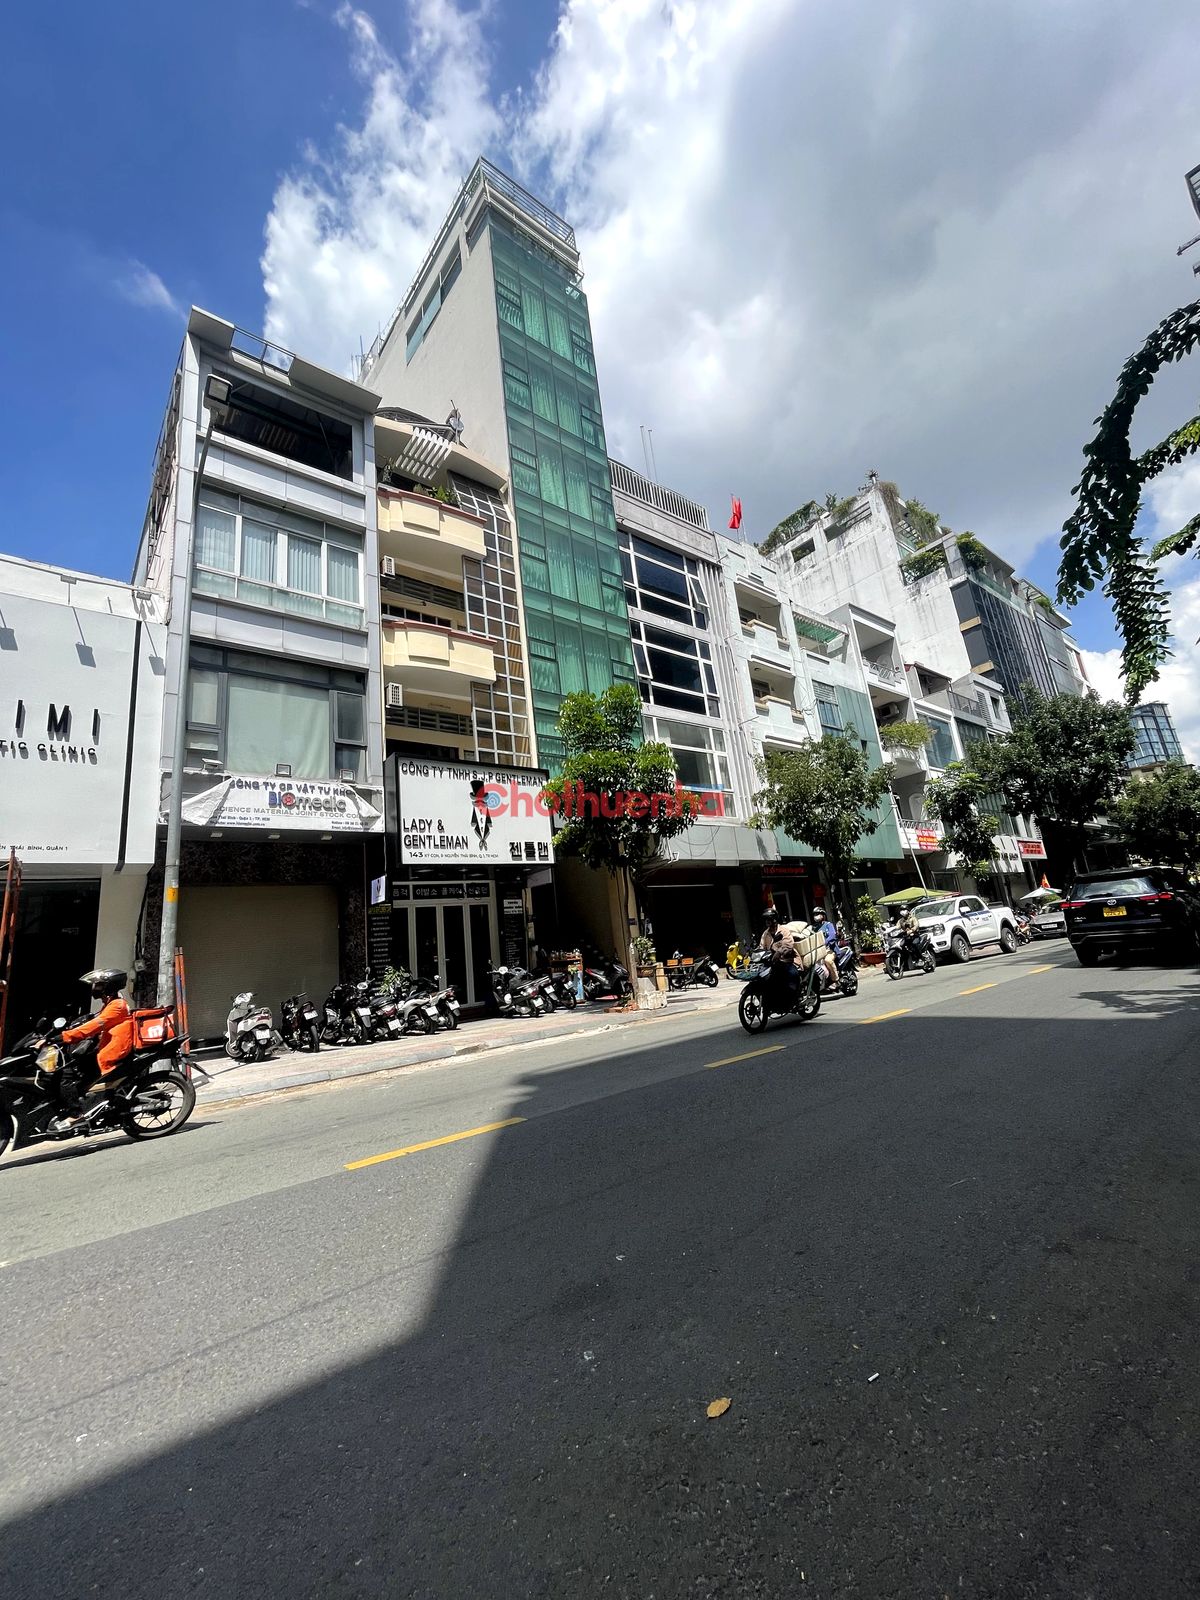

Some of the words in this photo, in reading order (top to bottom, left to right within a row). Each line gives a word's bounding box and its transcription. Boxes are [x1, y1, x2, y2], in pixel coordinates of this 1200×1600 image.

[37, 743, 97, 758] CLINIC
[401, 761, 429, 776] CÔNG
[431, 765, 444, 777] TY
[447, 767, 471, 781] TNHH
[495, 772, 544, 787] GENTLEMAN
[263, 781, 276, 791] TY
[403, 818, 432, 833] LADY
[437, 819, 445, 833] &
[403, 834, 468, 850] GENTLEMAN
[509, 841, 549, 861] 젠틀맨
